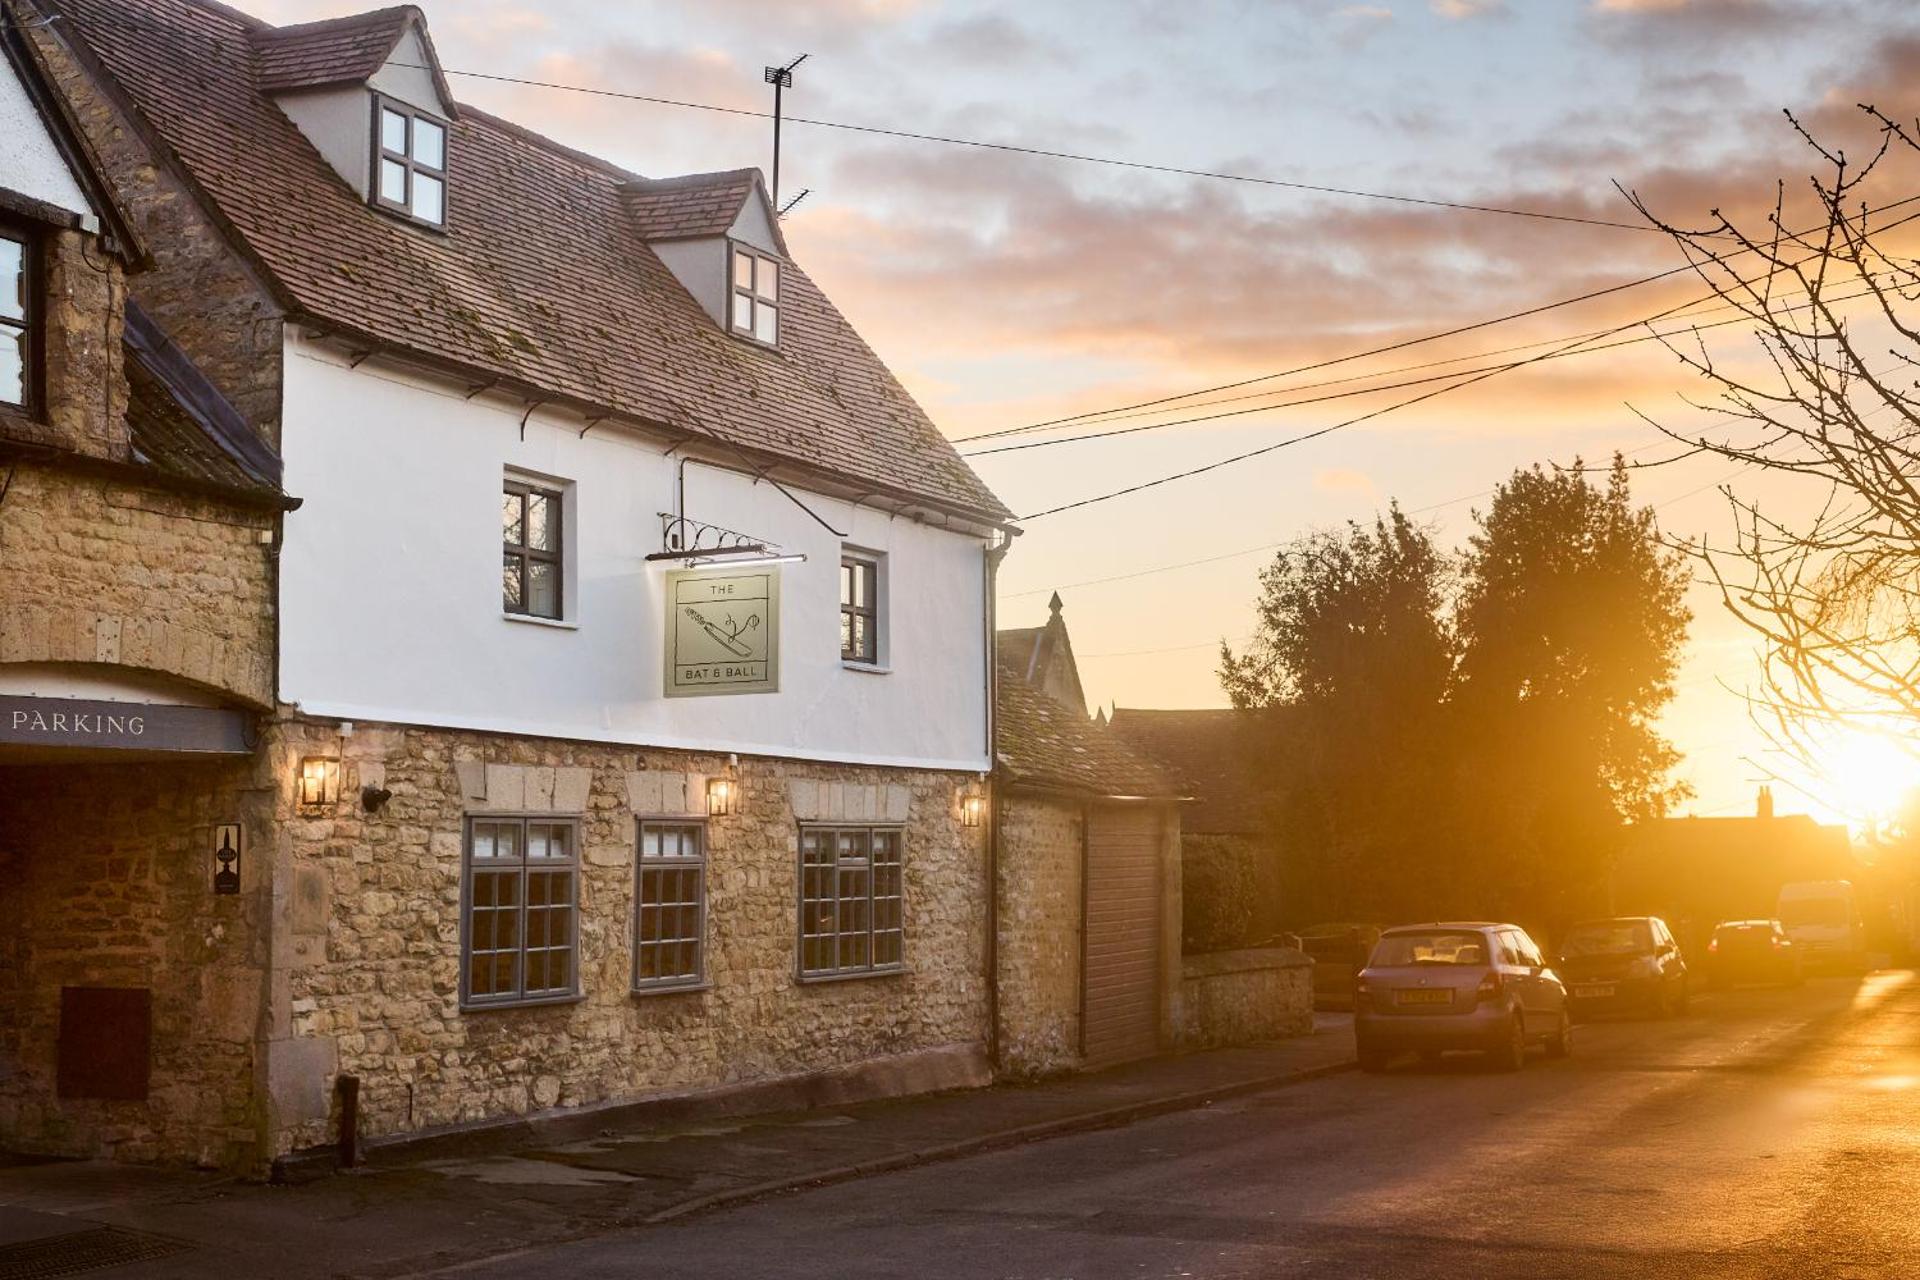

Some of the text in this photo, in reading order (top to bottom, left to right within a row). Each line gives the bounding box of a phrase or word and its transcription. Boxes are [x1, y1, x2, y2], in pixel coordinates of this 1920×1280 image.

[710, 585, 734, 594] THE
[685, 669, 708, 679] BAT
[726, 666, 757, 677] BALL
[12, 710, 145, 736] PARKING
